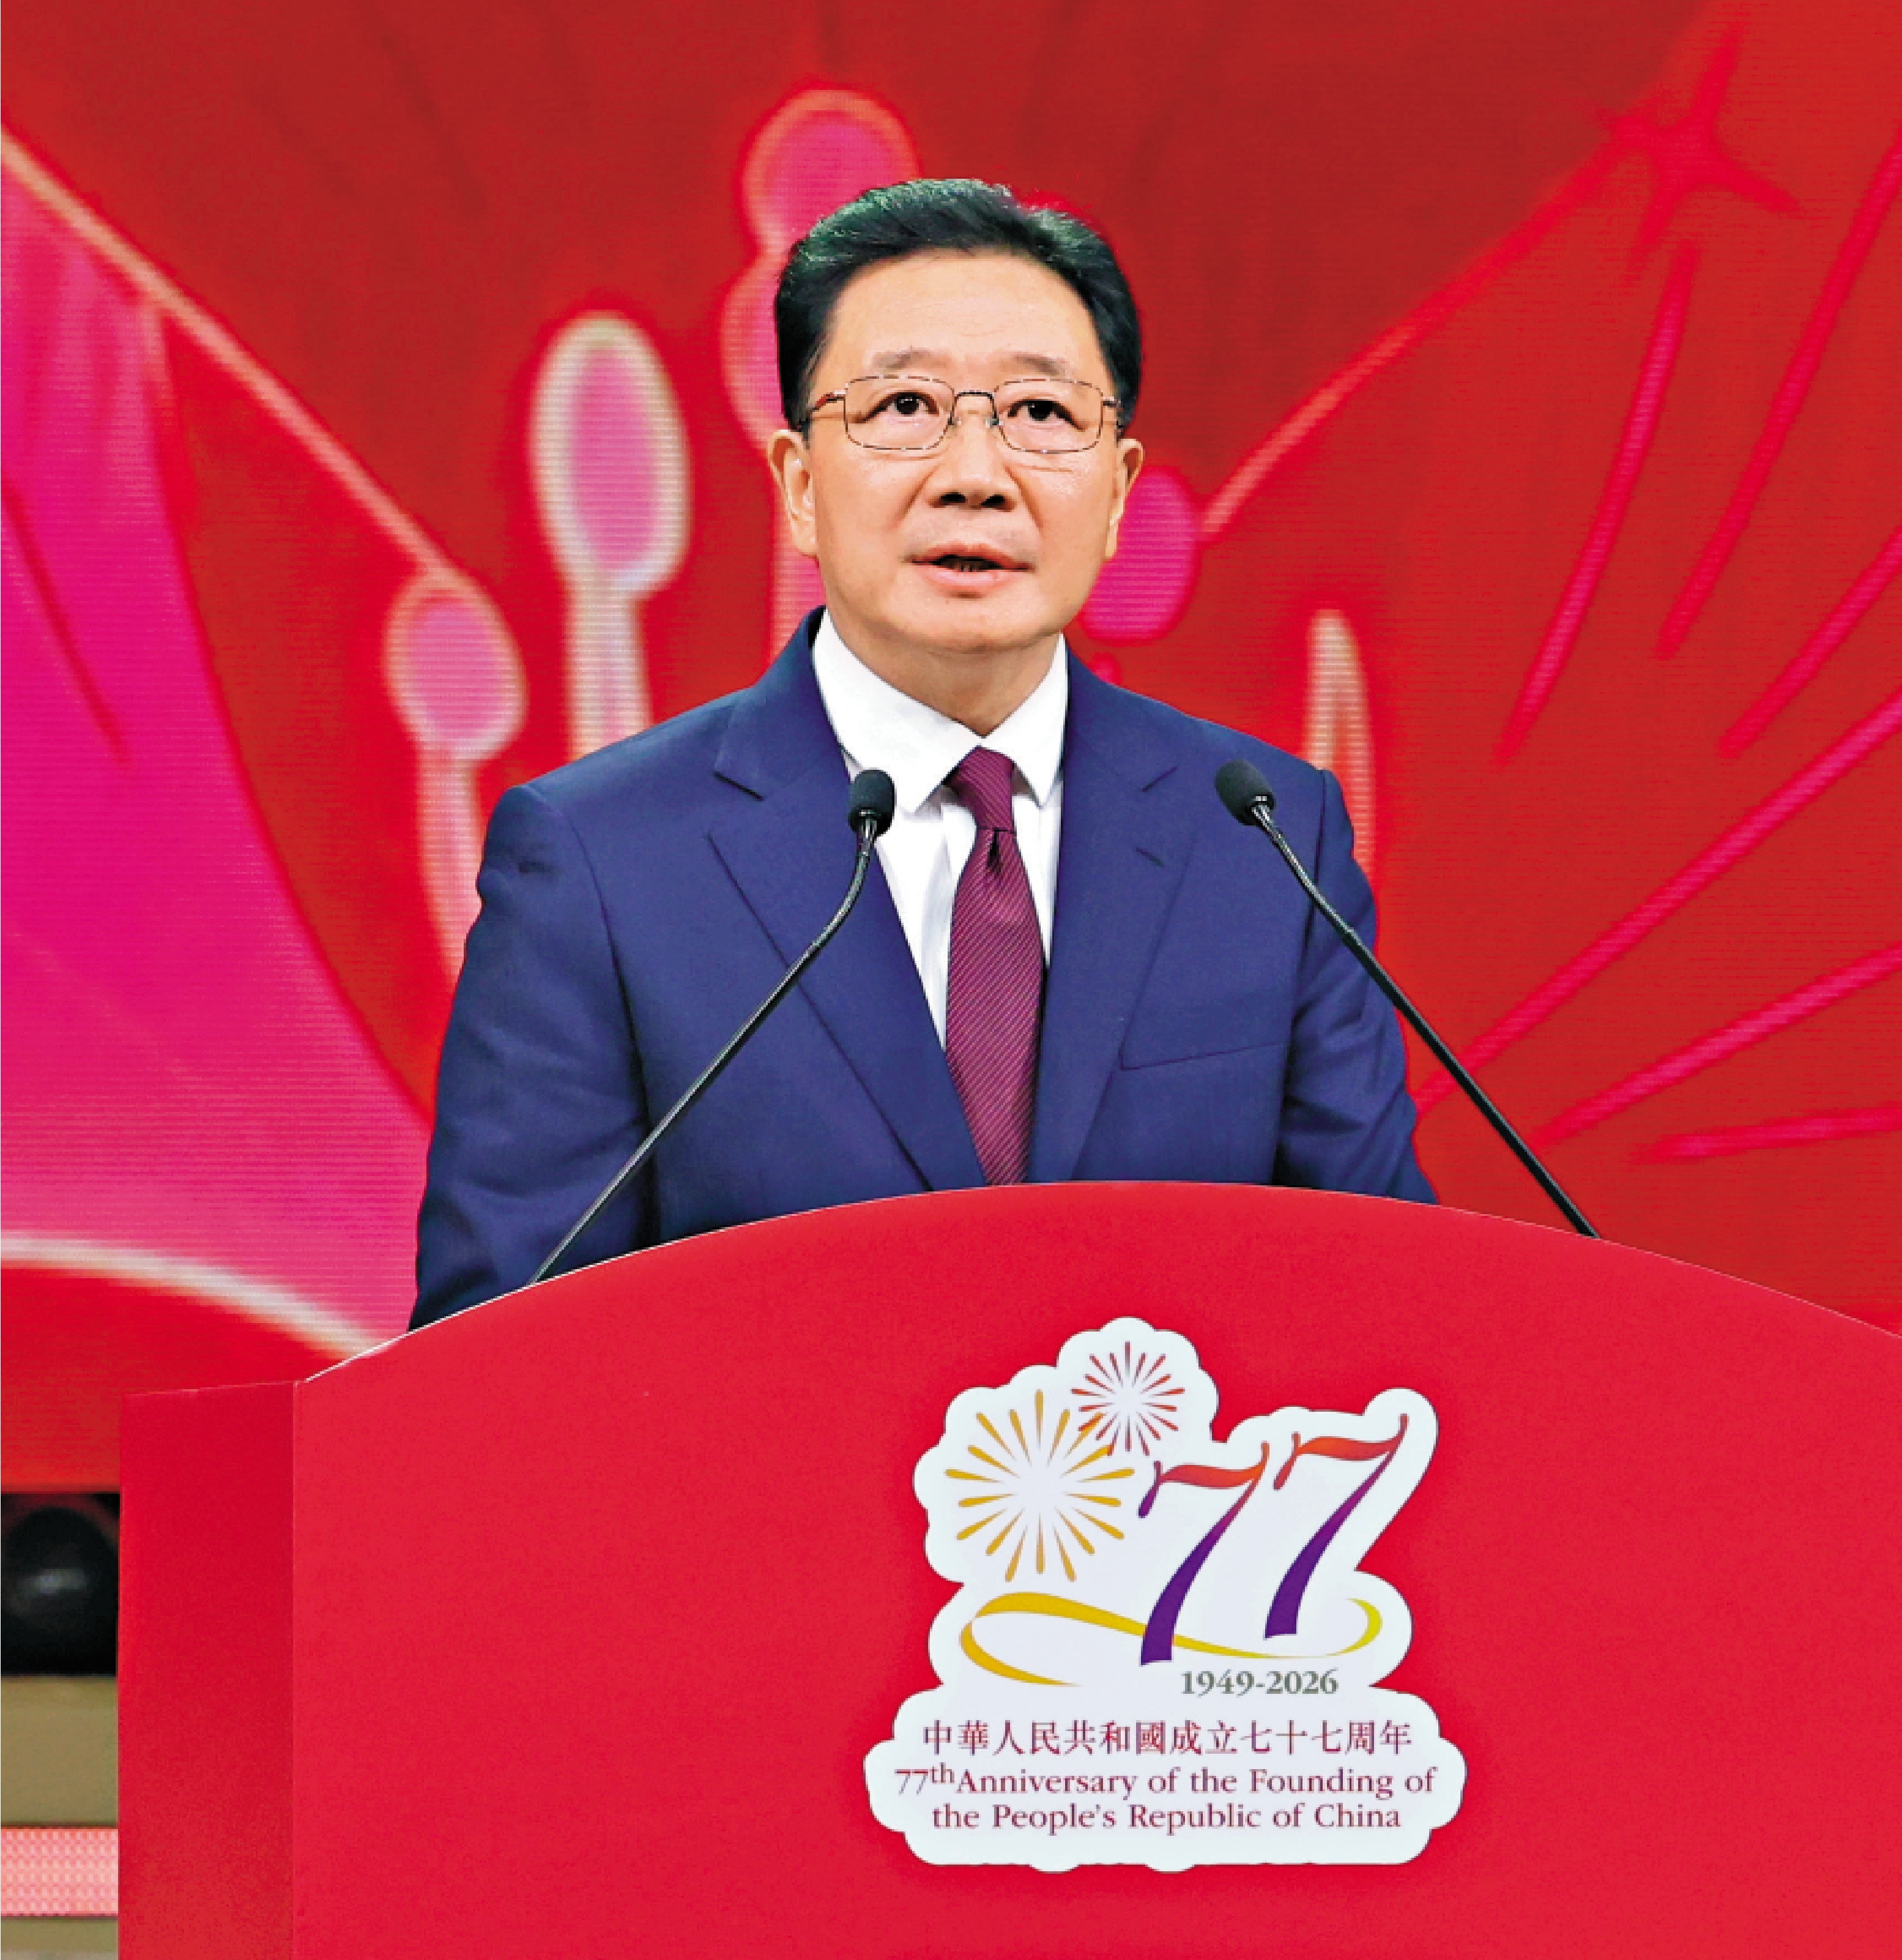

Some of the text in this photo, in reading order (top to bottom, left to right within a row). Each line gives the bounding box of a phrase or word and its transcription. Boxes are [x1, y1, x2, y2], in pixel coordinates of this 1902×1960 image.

[1138, 1413, 1408, 1666] 77
[1181, 1669, 1339, 1696] 1949-2026
[923, 1720, 1413, 1756] 中華人民共和國成立七十七周年
[1148, 1766, 1181, 1794] of
[1190, 1766, 1237, 1794] the
[1249, 1766, 1394, 1801] Founding
[1405, 1766, 1439, 1794] of
[932, 1802, 1401, 1836] the People's Republic of China
